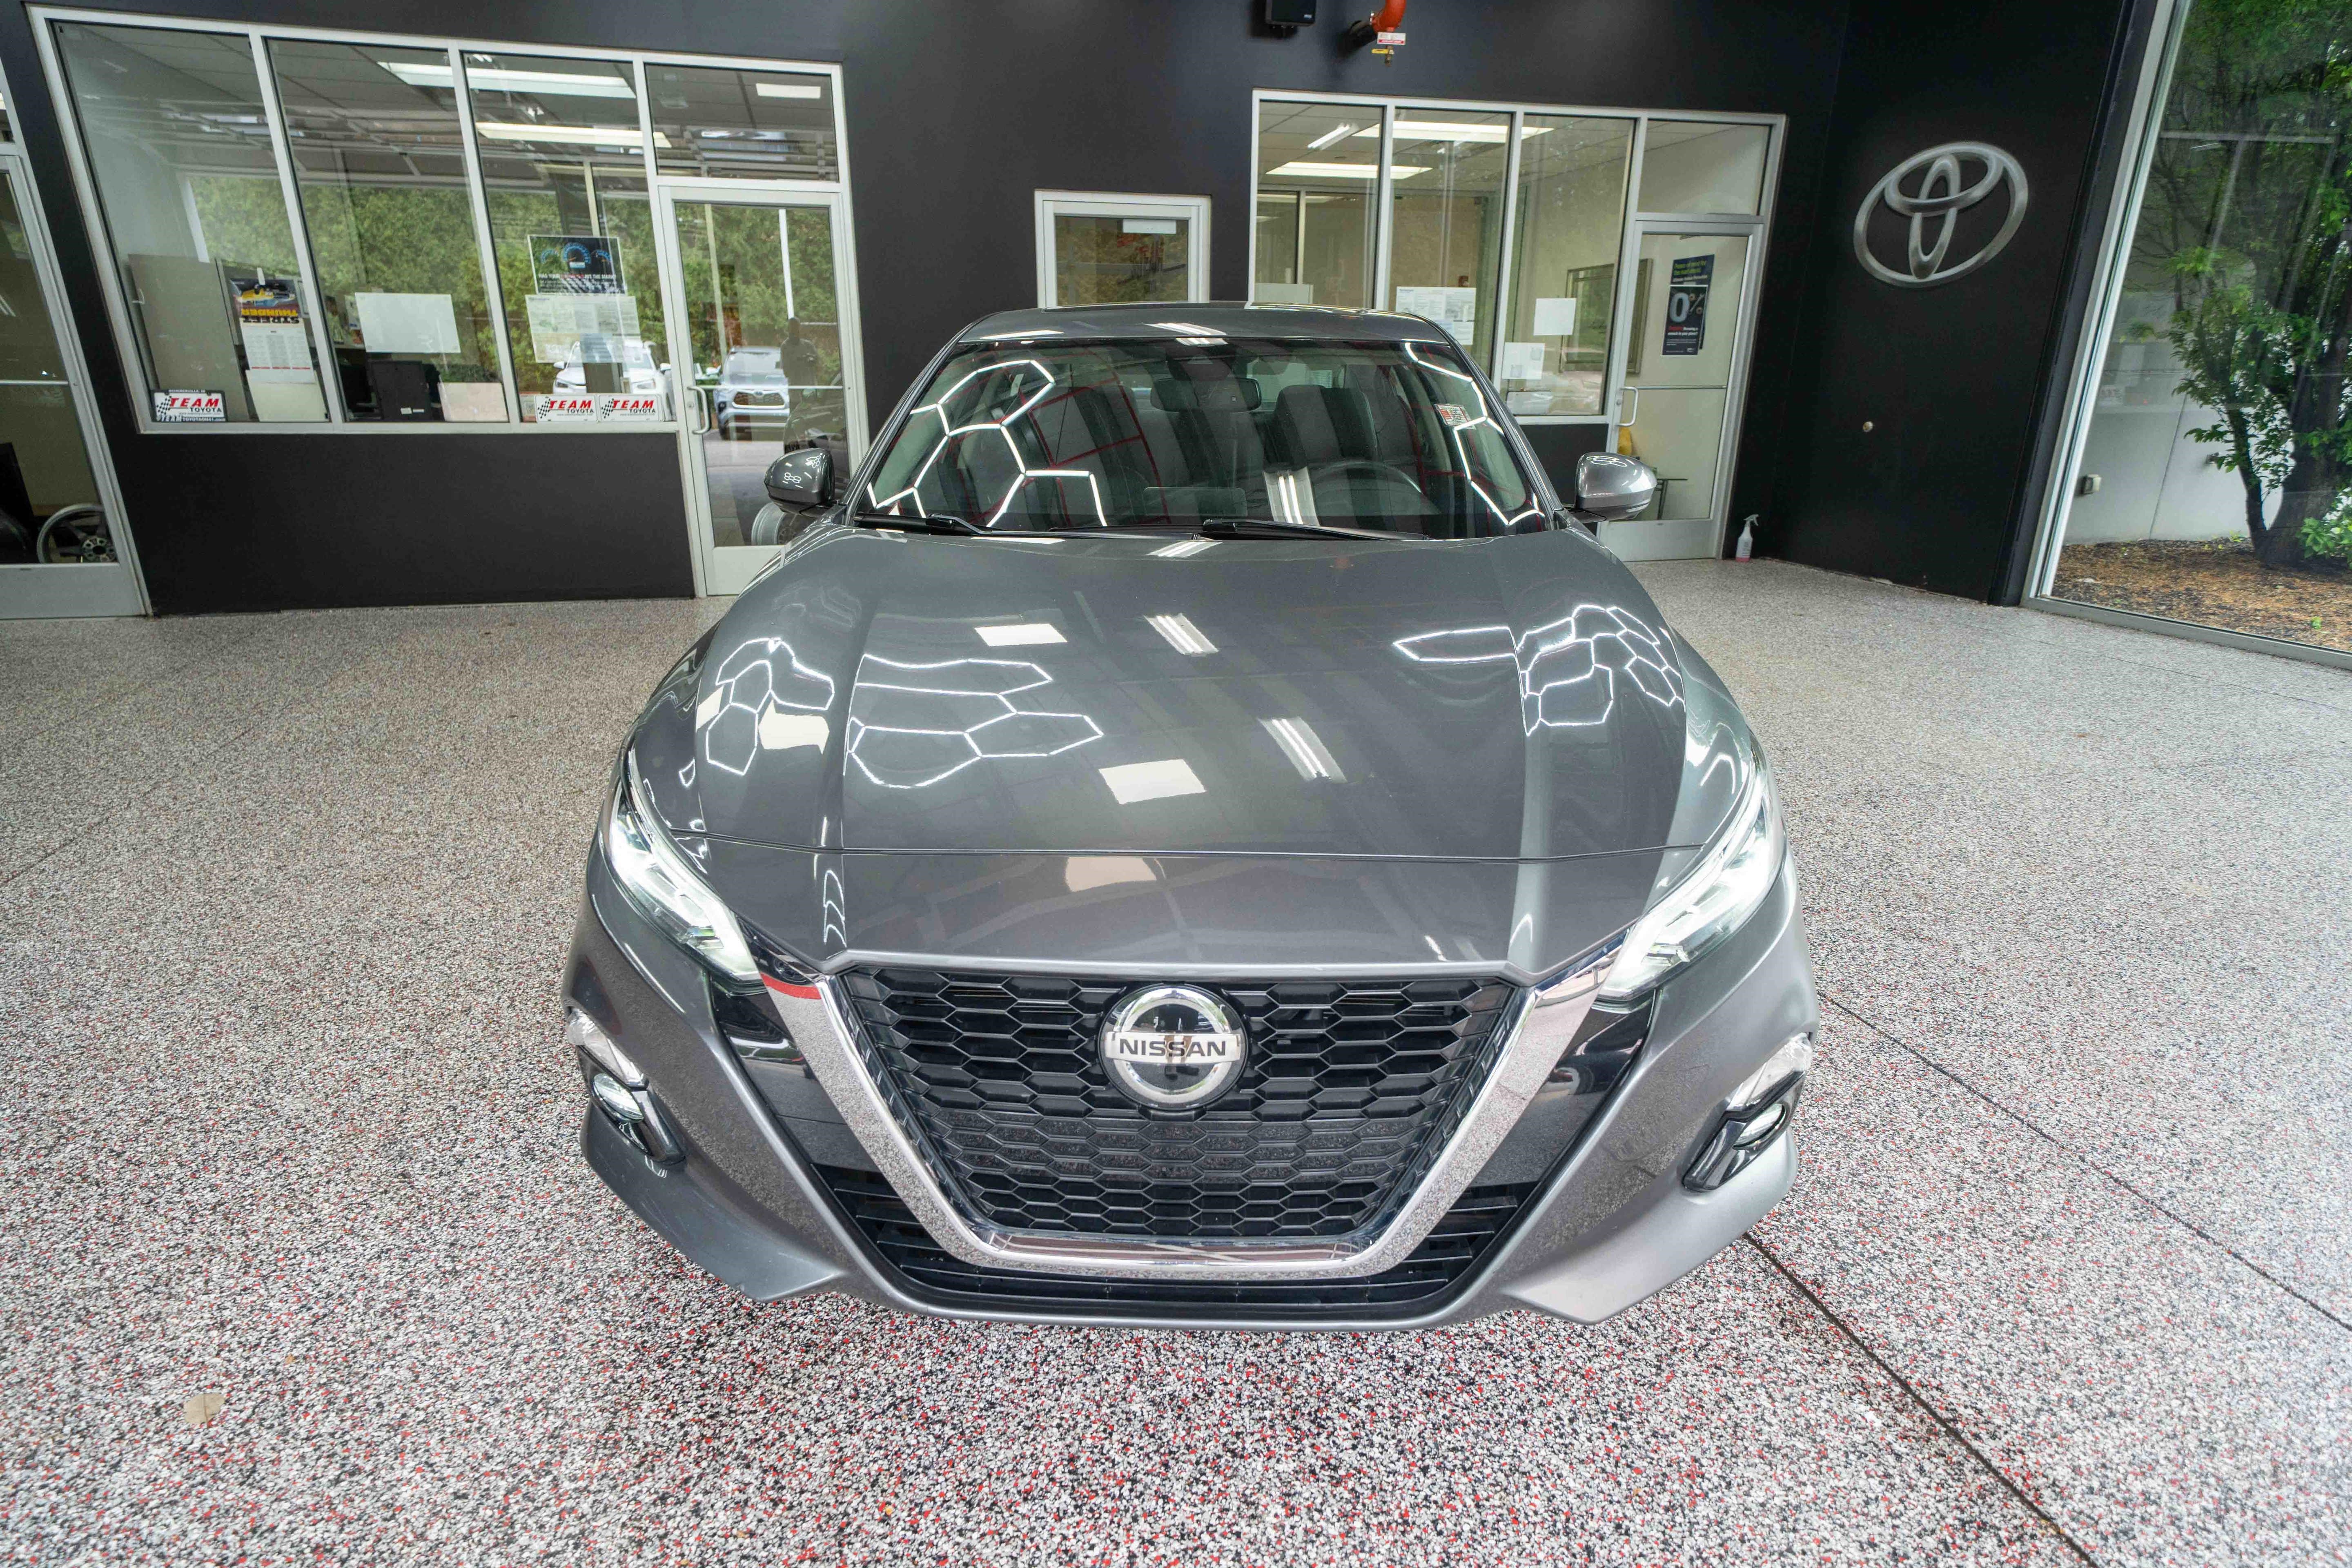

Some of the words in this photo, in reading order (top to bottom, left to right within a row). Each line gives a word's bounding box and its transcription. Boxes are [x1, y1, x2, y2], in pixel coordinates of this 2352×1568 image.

[170, 397, 219, 407] TEAM
[549, 400, 592, 409] TEAM
[612, 400, 654, 409] TEAM
[1119, 1038, 1226, 1057] NISSAN
